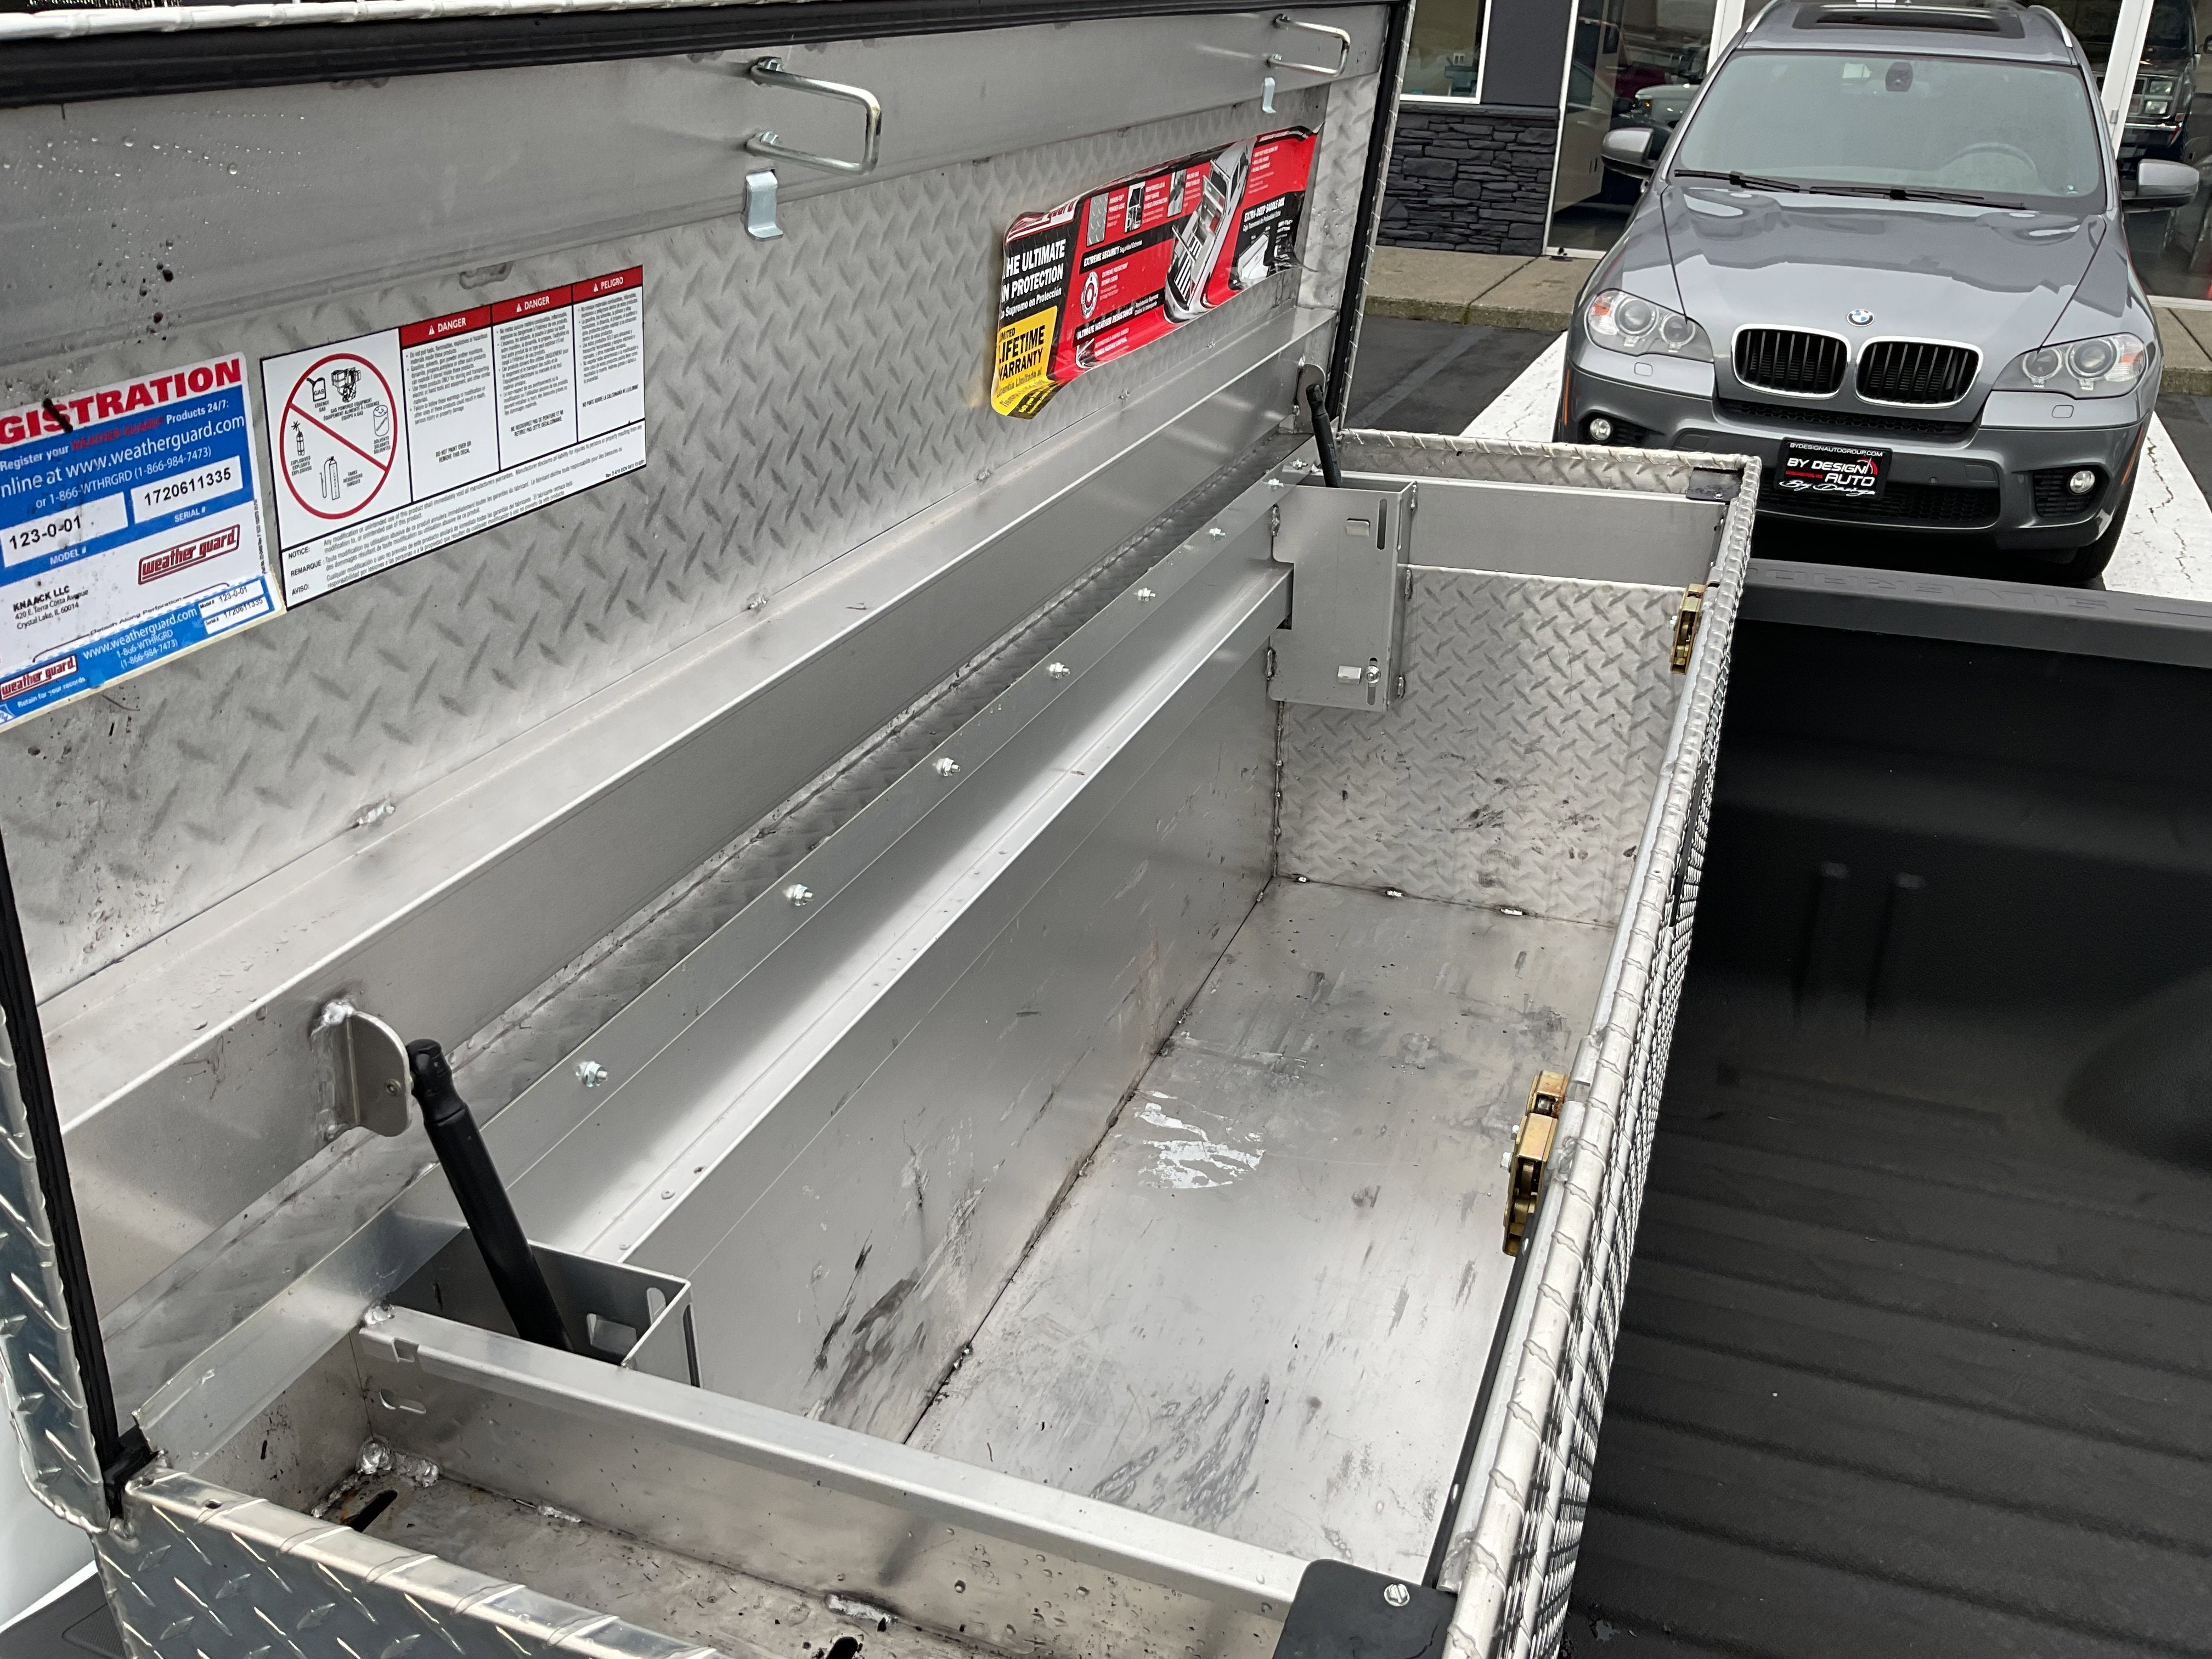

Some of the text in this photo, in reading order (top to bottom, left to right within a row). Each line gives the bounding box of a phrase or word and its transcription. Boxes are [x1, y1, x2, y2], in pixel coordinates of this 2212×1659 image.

[1003, 239, 1066, 279] HE ULTIMATE
[601, 276, 623, 290] PELIGRO
[1011, 263, 1064, 299] PROTECTION
[524, 296, 550, 310] DANGER
[1005, 301, 1029, 317] Supremo
[1029, 299, 1036, 307] en
[1036, 287, 1062, 304] Protección
[437, 317, 466, 333] DANGER
[0, 358, 242, 444] GISTRATION
[0, 450, 44, 474] Register
[46, 443, 69, 461] your
[166, 405, 206, 427] Products
[207, 398, 229, 415] 24/7:
[0, 411, 245, 501] nline at www.weatherguard.com
[1790, 443, 1883, 457] BYDESIGNAUTOGROUP.COM
[35, 445, 212, 510] or 1-866-WTHRGRD (1-866-984-7473)
[1787, 458, 1866, 474] BY DESIGN
[144, 466, 231, 507] 1720611335
[1779, 479, 1812, 491] By
[1825, 473, 1875, 487] AUTO
[174, 507, 200, 523] SERIAL
[9, 515, 81, 551] 123-0-01
[49, 548, 80, 565] MODEL
[141, 543, 196, 576] weather
[198, 528, 236, 558] guard
[288, 545, 311, 560] NOTICE:
[290, 560, 321, 577] REMARQUE
[13, 585, 70, 612] KNAACK LLC
[219, 585, 247, 603] 123-0-01
[291, 582, 310, 596] AVISO:
[15, 610, 27, 620] 420
[34, 602, 48, 613] Terra
[49, 596, 66, 608] Cotta
[16, 616, 37, 631] Crystal
[38, 610, 54, 623] Lake,
[60, 601, 79, 615] 60014
[119, 612, 140, 625] Along
[223, 596, 263, 619] 1720611335
[83, 605, 198, 661] www.weatherguard.com
[120, 637, 178, 669] (1-866-984-7473)
[2, 657, 76, 696] weather guard
